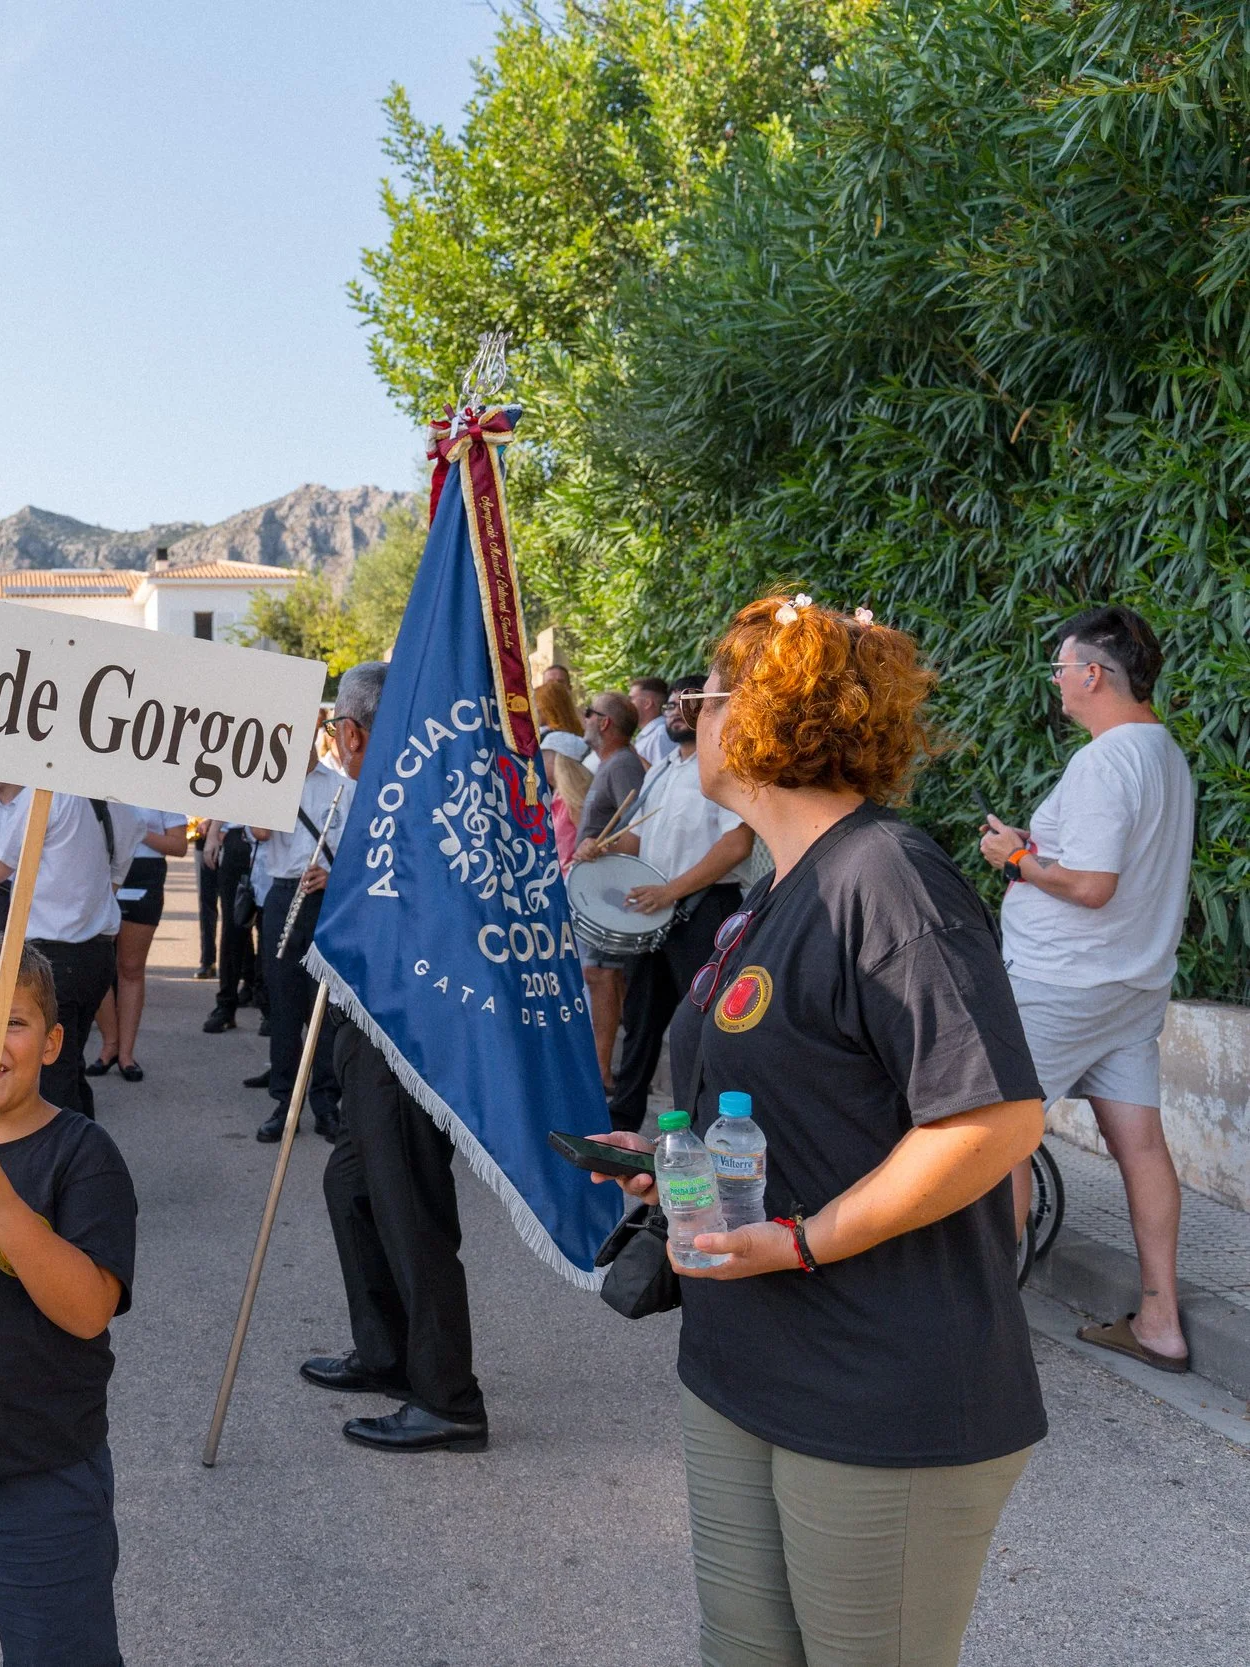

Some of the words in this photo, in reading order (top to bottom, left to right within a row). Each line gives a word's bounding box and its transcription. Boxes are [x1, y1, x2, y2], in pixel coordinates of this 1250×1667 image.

[78, 664, 294, 798] Gorgos
[478, 922, 579, 963] CODA
[414, 959, 496, 1014] GATA
[521, 1008, 547, 1027] DE
[521, 971, 560, 998] 2018
